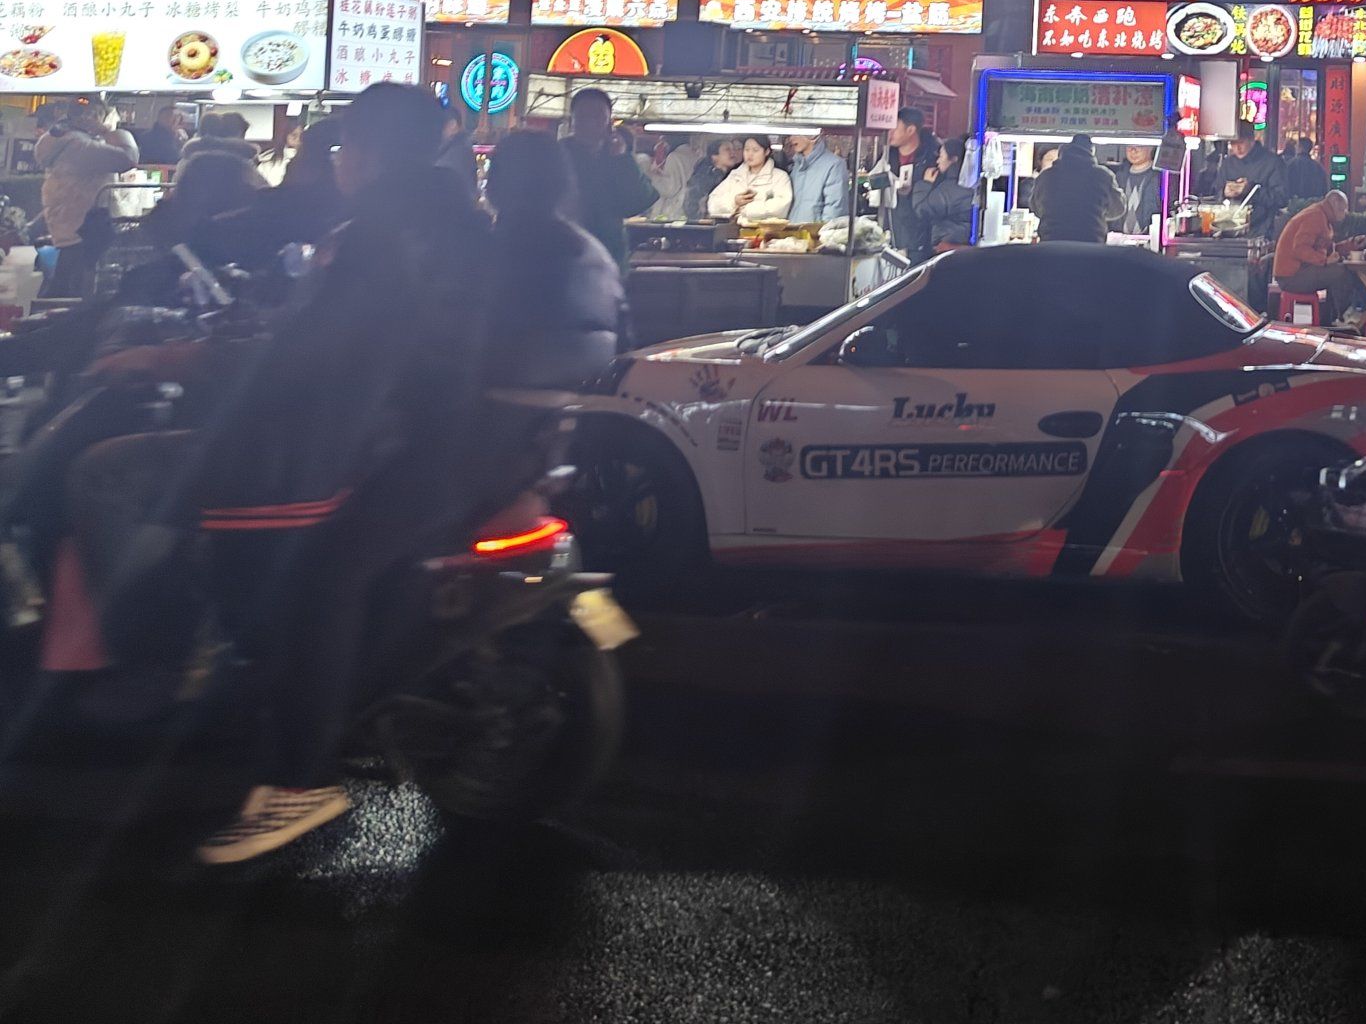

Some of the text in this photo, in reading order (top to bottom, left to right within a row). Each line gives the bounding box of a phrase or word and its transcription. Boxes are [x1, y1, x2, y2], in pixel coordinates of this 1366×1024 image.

[63, 1, 155, 18] 酒酿小丸子
[165, 1, 240, 18] 冰糖烤梨
[256, 0, 328, 18] 牛奶鸡蛋
[1042, 5, 1137, 27] 东奔西跑
[1042, 29, 1164, 51] 不如吃东北烧烤
[804, 449, 1080, 477] GT4RS PERFORMANCE
